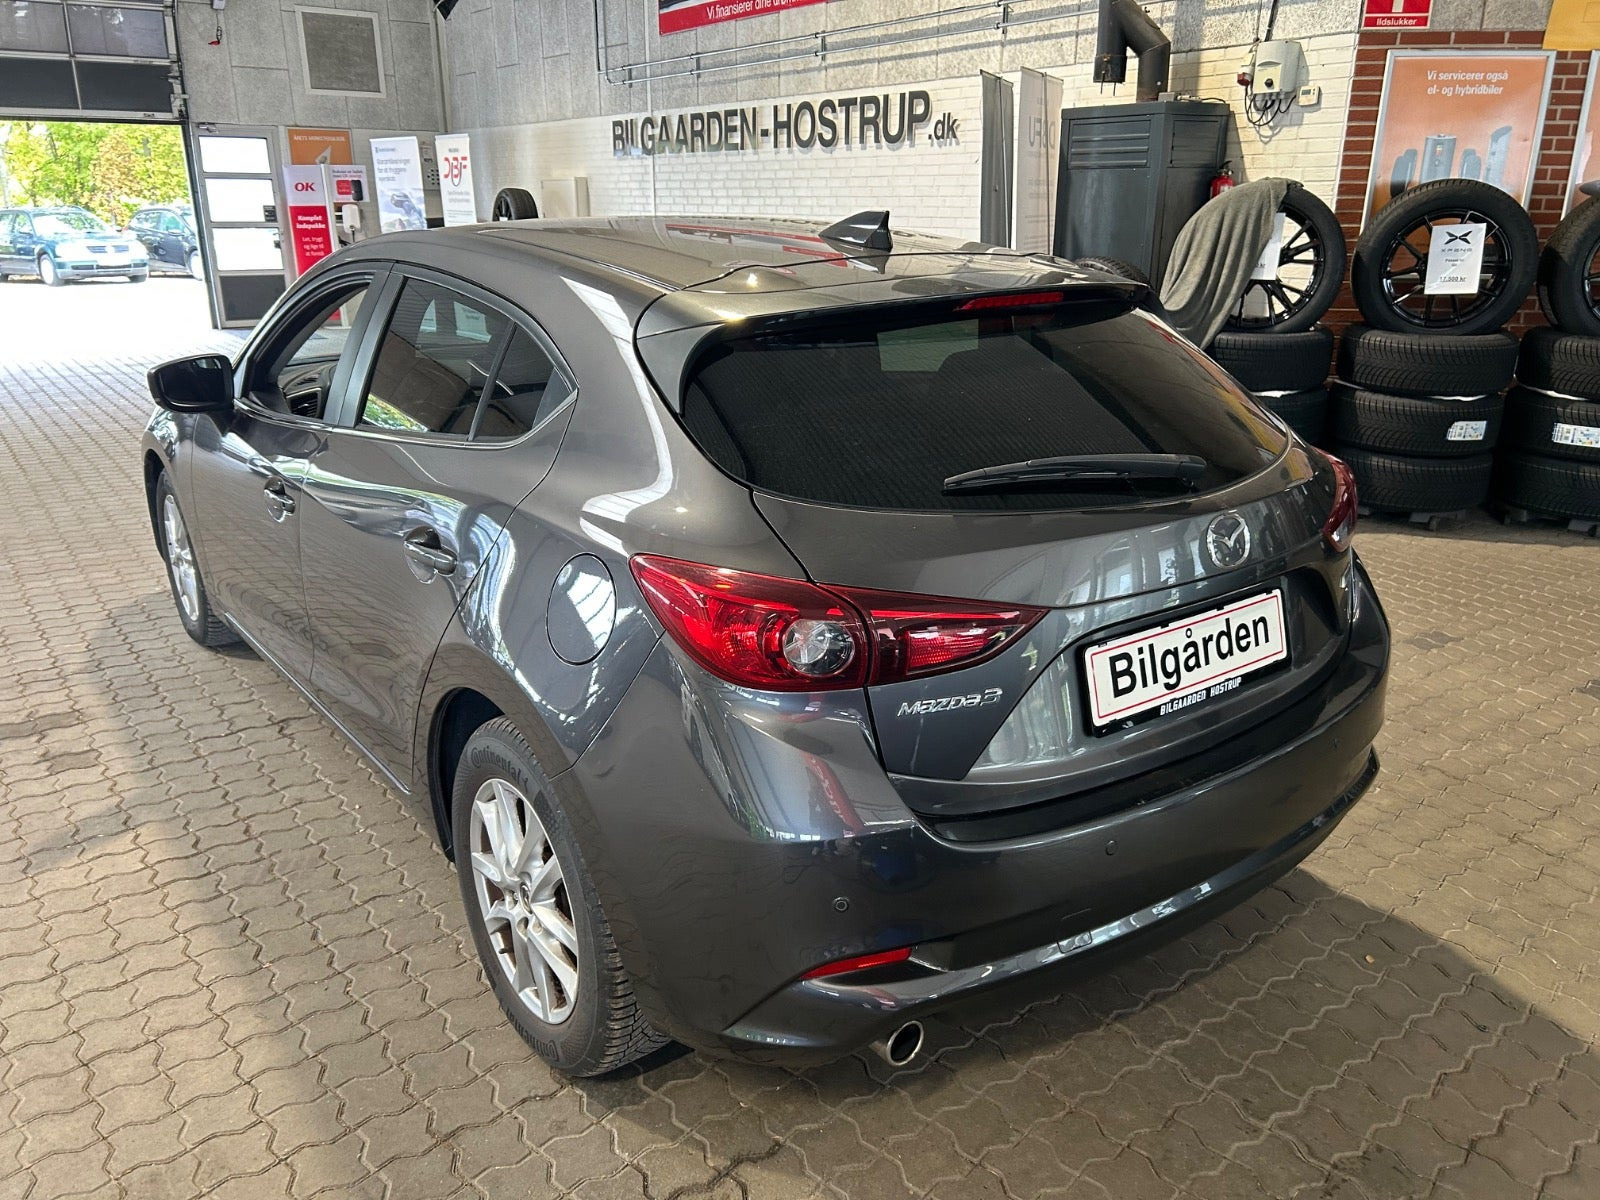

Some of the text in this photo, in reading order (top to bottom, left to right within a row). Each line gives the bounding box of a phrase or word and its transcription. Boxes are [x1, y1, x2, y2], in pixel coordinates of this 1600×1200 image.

[707, 6, 715, 19] Vi
[715, 1, 753, 18] finansierer
[1376, 17, 1418, 26] Ildslukker
[1427, 70, 1509, 83] Vi servicerer også
[1427, 84, 1504, 97] el- og hybridbiler
[294, 182, 316, 192] OK
[1109, 615, 1270, 698] Bilgården
[1160, 676, 1242, 716] BILGAARDEN HOSTRUP
